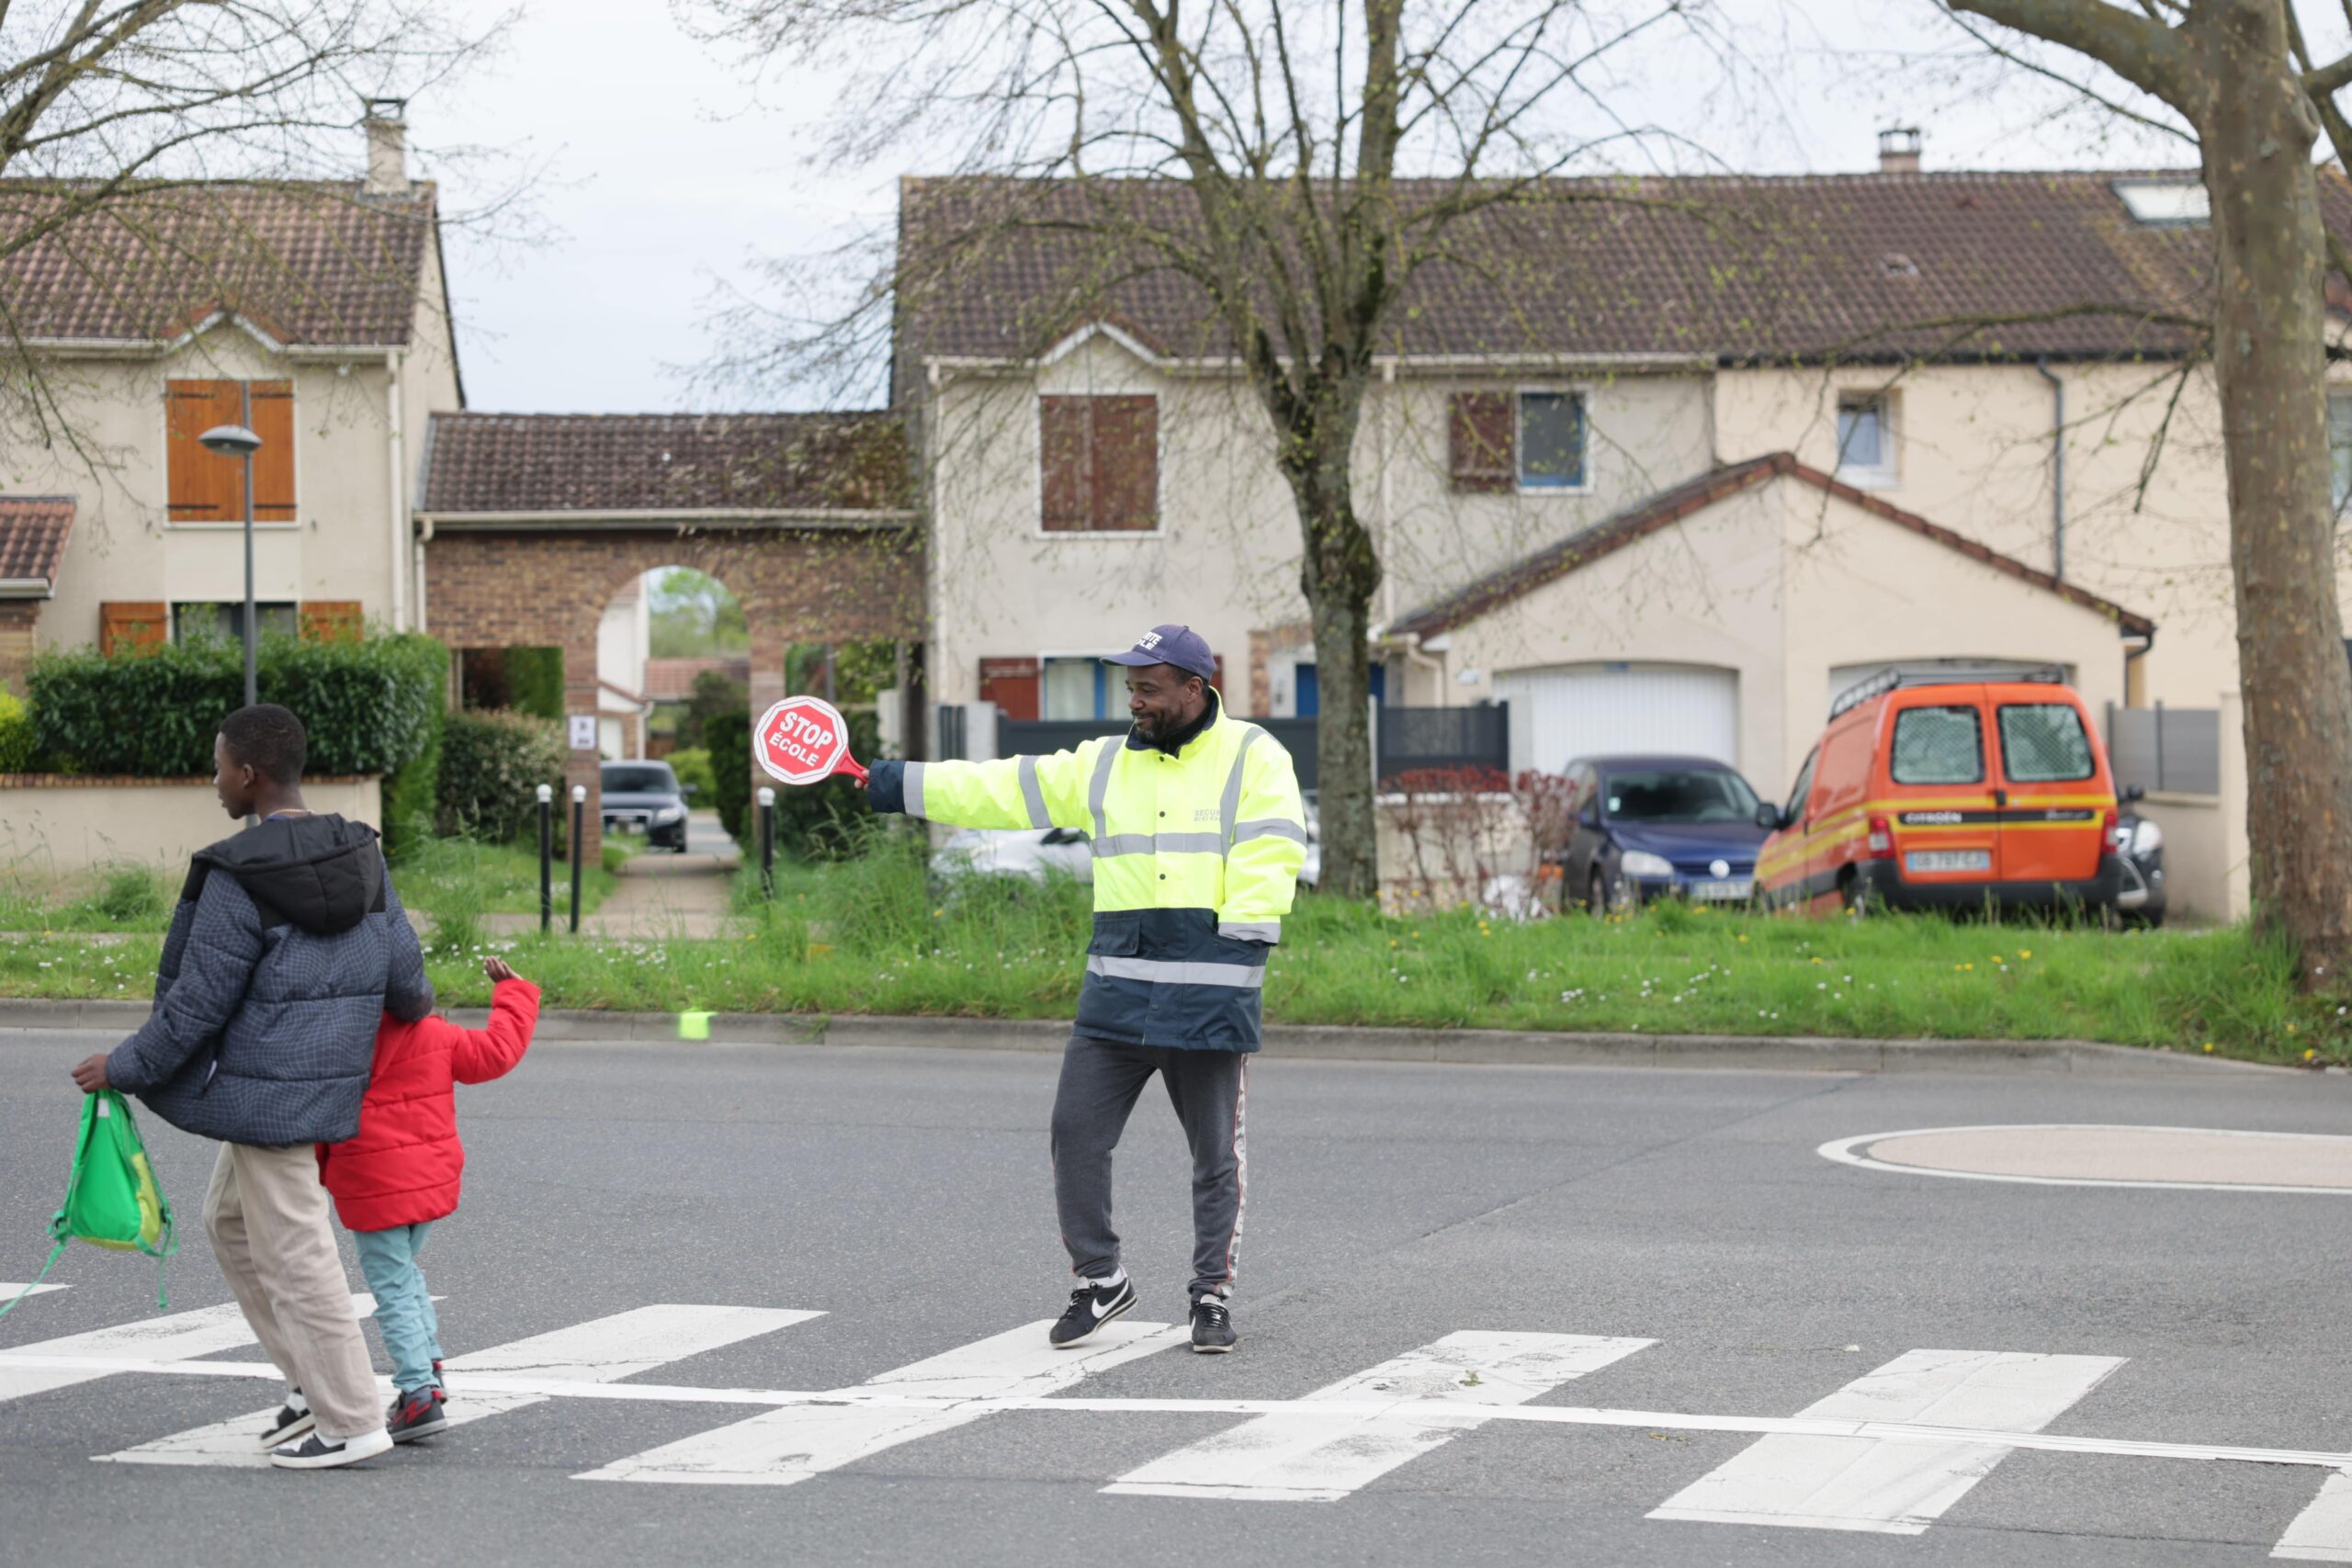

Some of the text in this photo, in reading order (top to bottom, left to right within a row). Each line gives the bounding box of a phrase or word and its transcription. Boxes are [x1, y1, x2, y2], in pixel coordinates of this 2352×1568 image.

[779, 711, 833, 750] STOP
[769, 732, 820, 767] ÉCOLE
[1905, 811, 1962, 825] CITROËN
